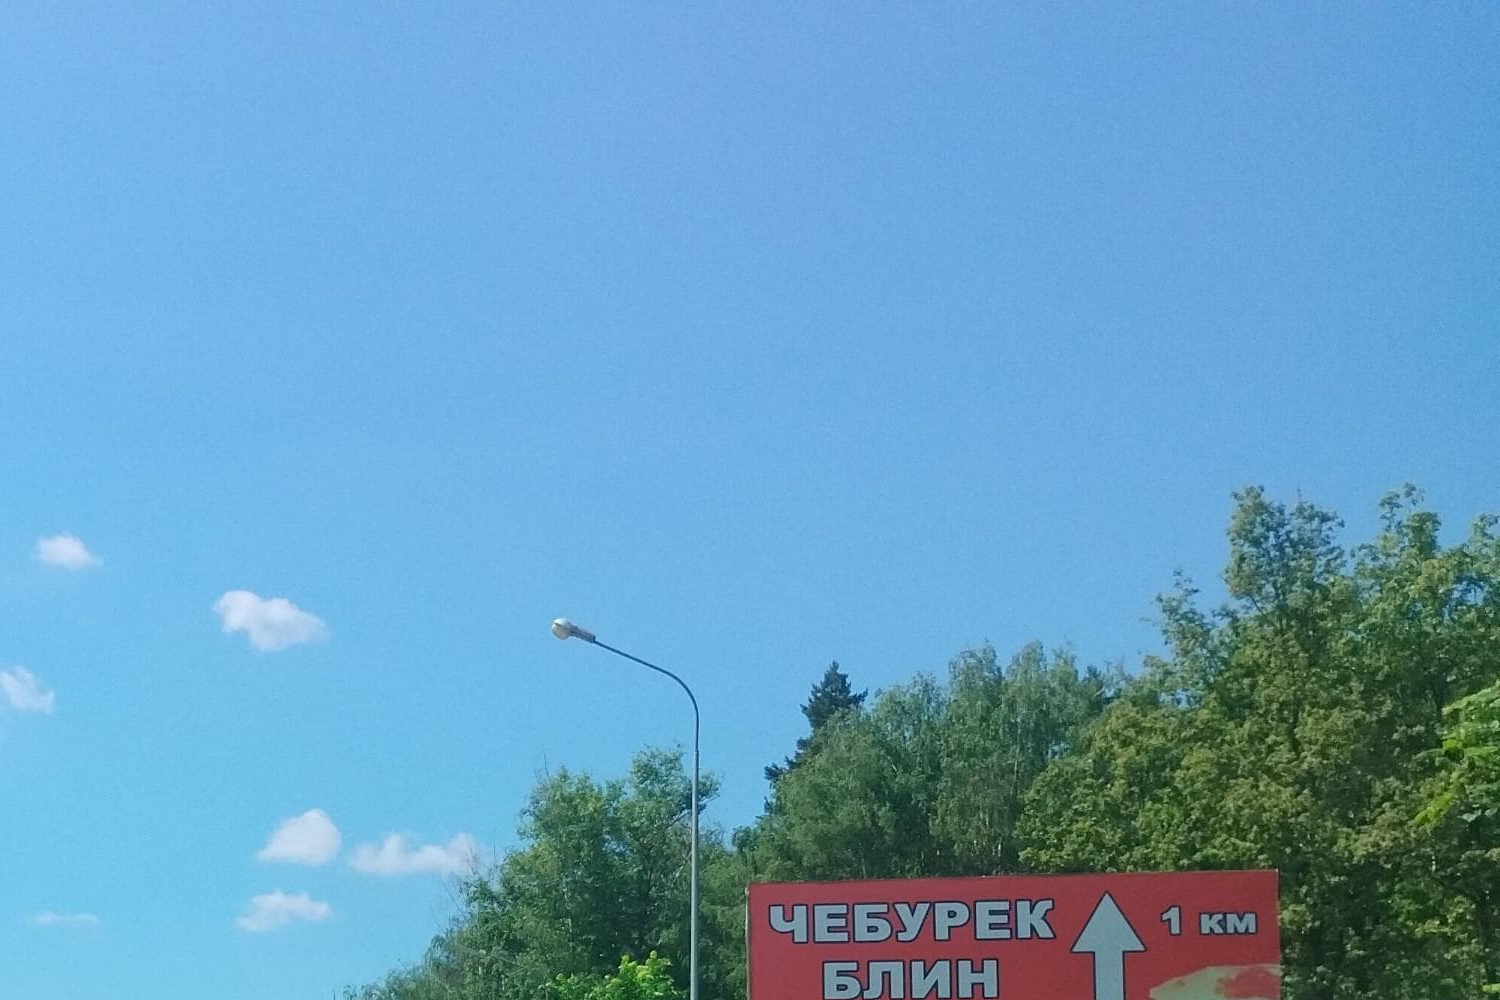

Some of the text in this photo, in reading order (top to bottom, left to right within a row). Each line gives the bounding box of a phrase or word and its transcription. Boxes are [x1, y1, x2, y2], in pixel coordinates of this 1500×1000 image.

[768, 899, 1056, 944] ЧЕБУРЕК
[1161, 905, 1258, 936] 1 км
